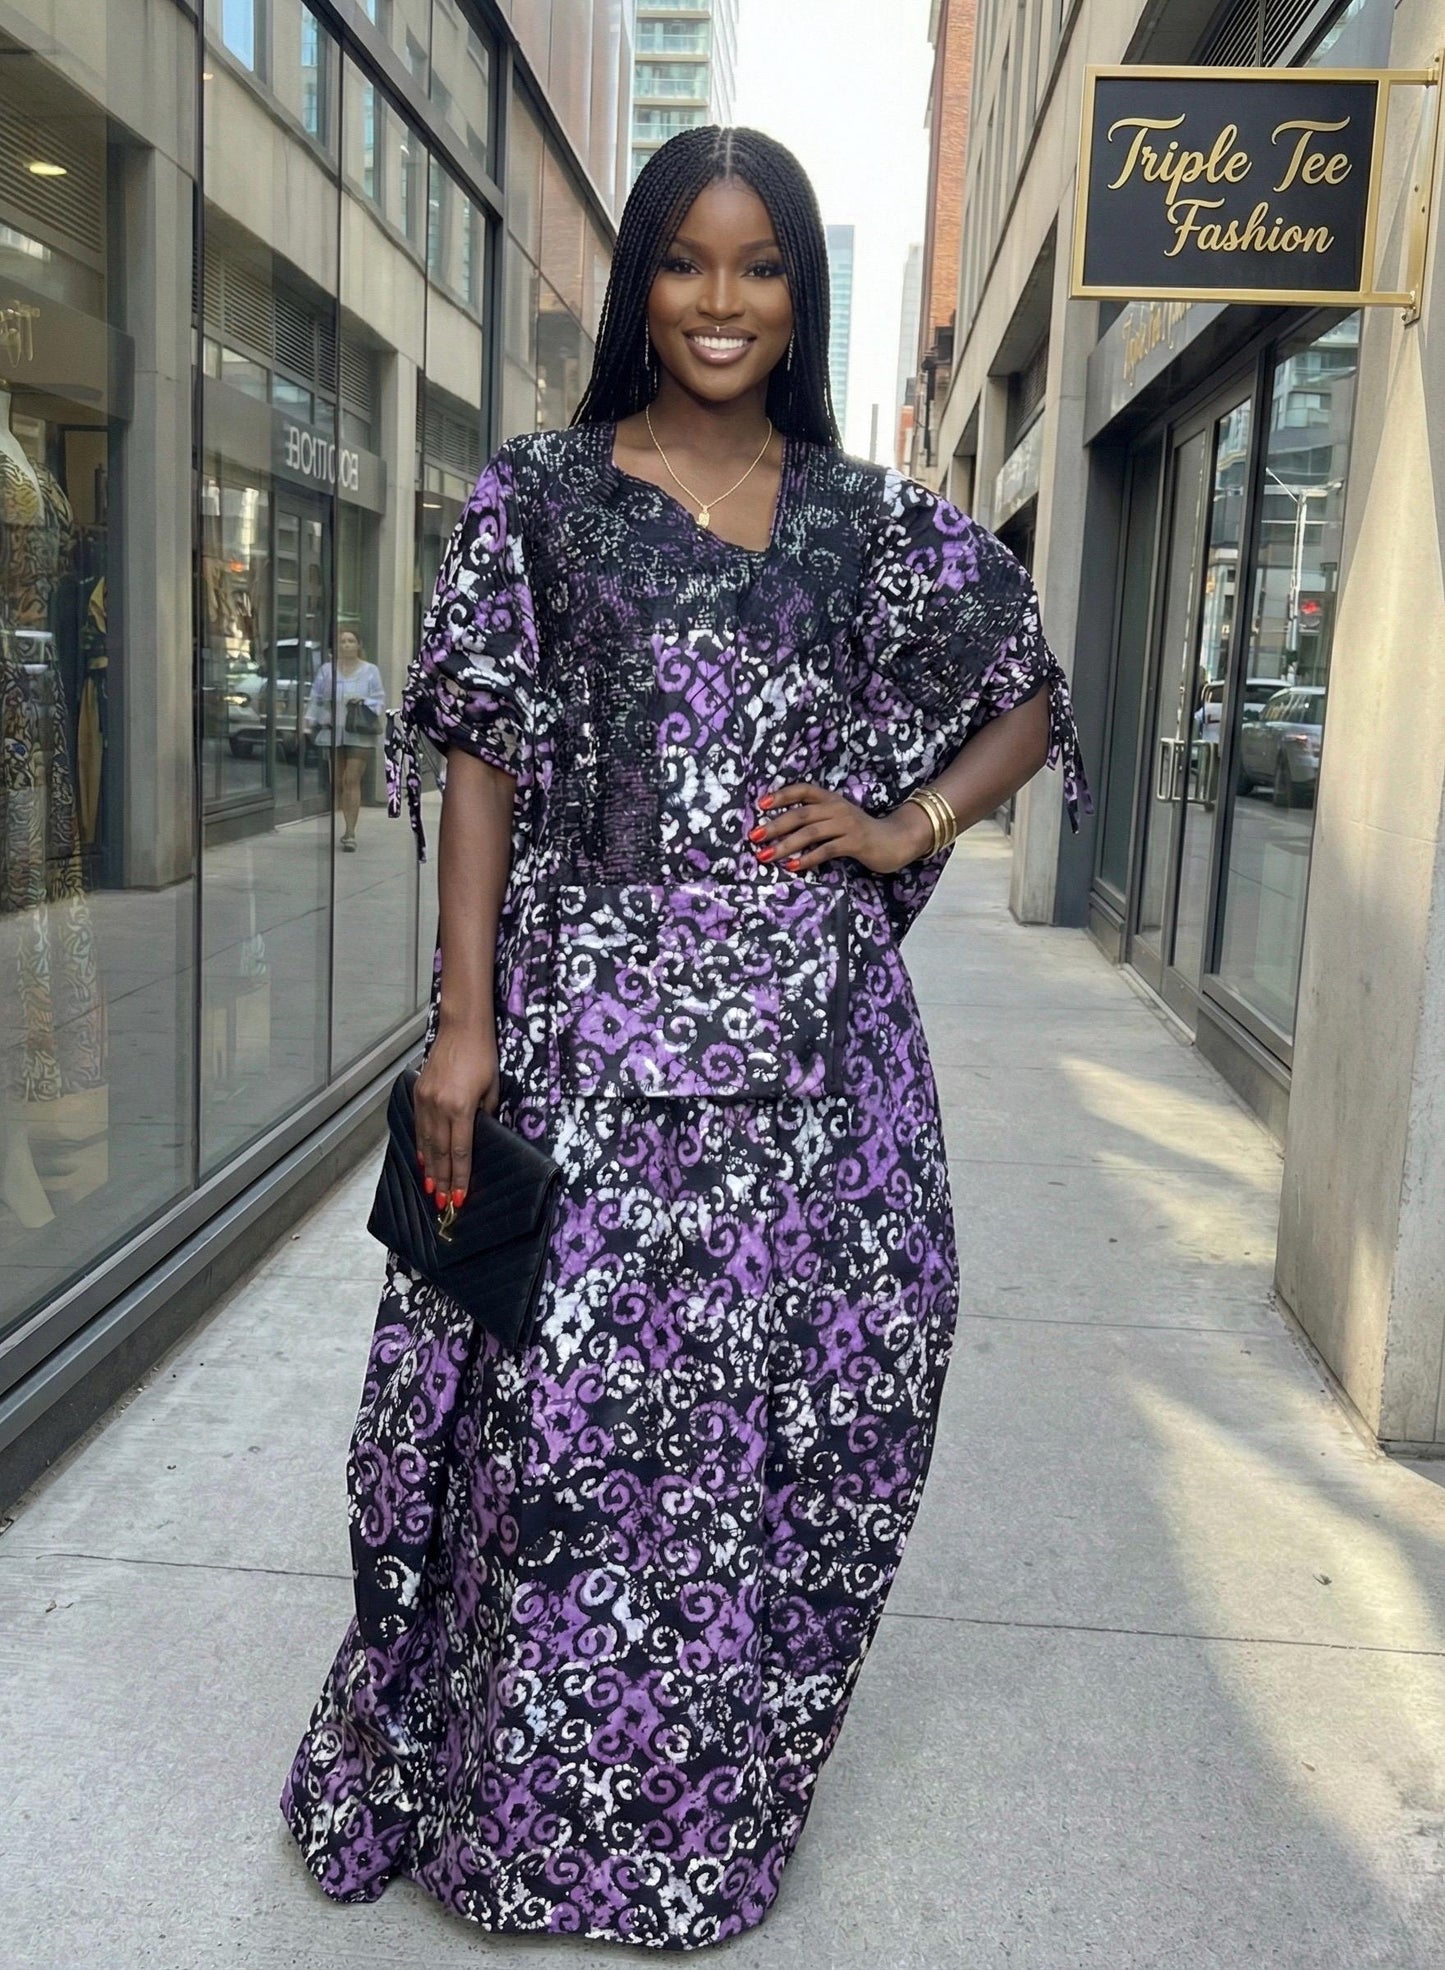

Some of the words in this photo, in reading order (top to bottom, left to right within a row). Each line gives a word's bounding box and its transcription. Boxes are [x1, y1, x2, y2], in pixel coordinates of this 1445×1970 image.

[1107, 113, 1252, 205] Triple
[1271, 116, 1353, 192] Tee
[1163, 198, 1335, 257] Fashion
